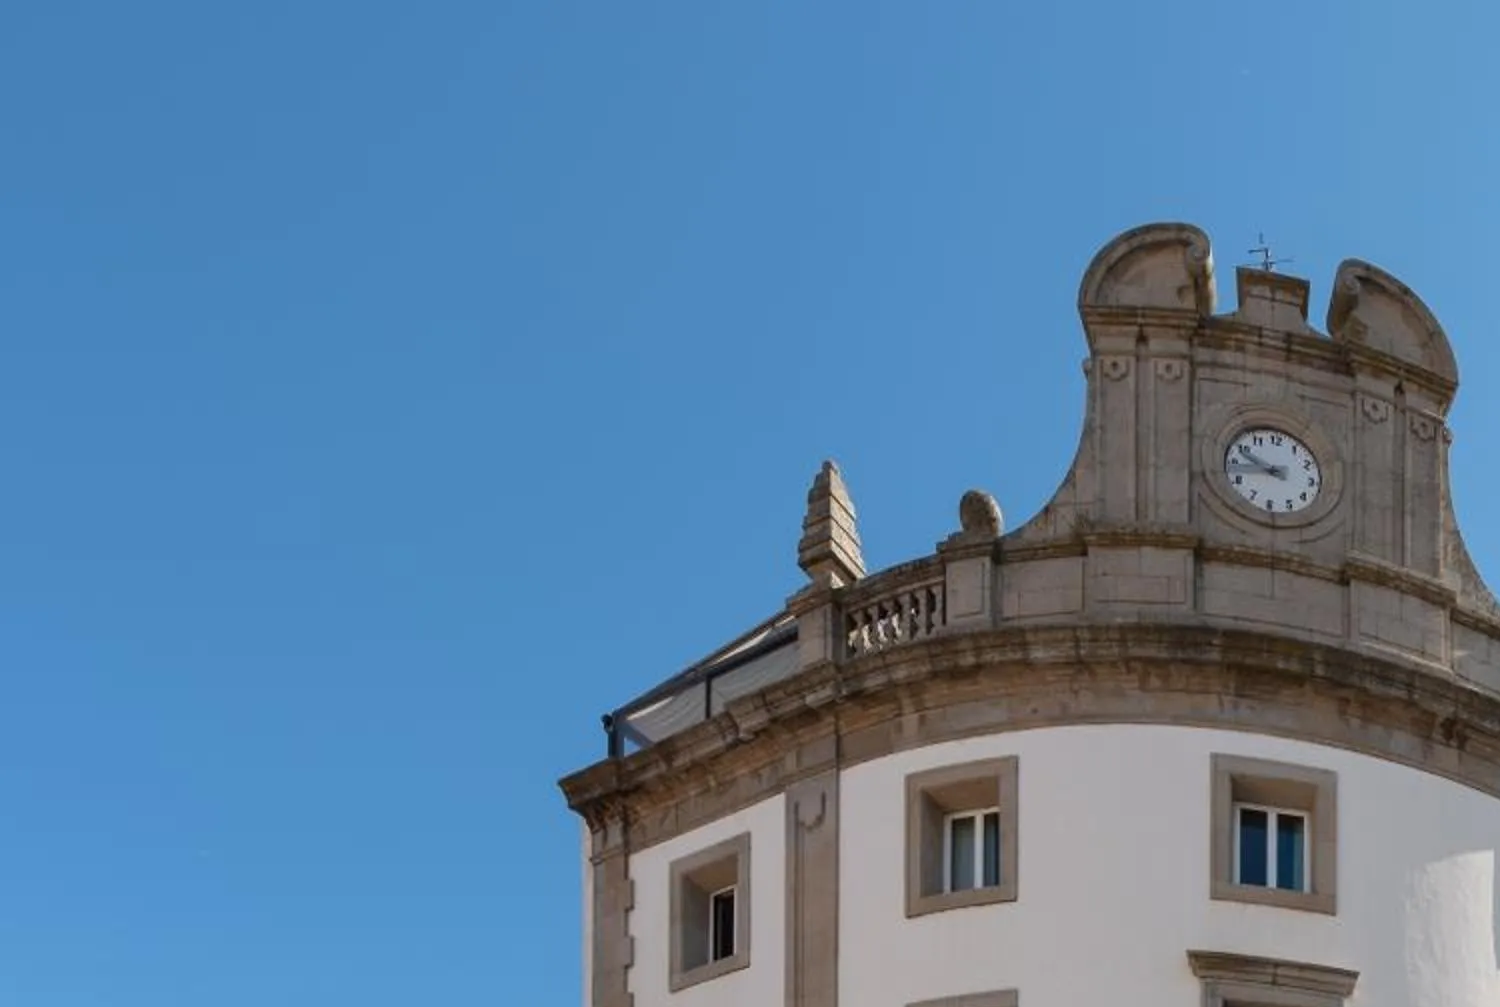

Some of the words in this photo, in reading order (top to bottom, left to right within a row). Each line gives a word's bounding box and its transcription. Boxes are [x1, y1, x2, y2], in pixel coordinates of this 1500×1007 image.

[1253, 436, 1263, 448] 11
[1270, 435, 1283, 447] 12
[1238, 444, 1250, 455] 10
[1292, 445, 1297, 455] 1
[1303, 459, 1311, 470] 2
[1235, 475, 1242, 485] 8
[1308, 477, 1315, 487] 3
[1250, 490, 1257, 501] 7
[1300, 492, 1307, 501] 4
[1266, 500, 1273, 510] 6
[1286, 499, 1293, 510] 5
